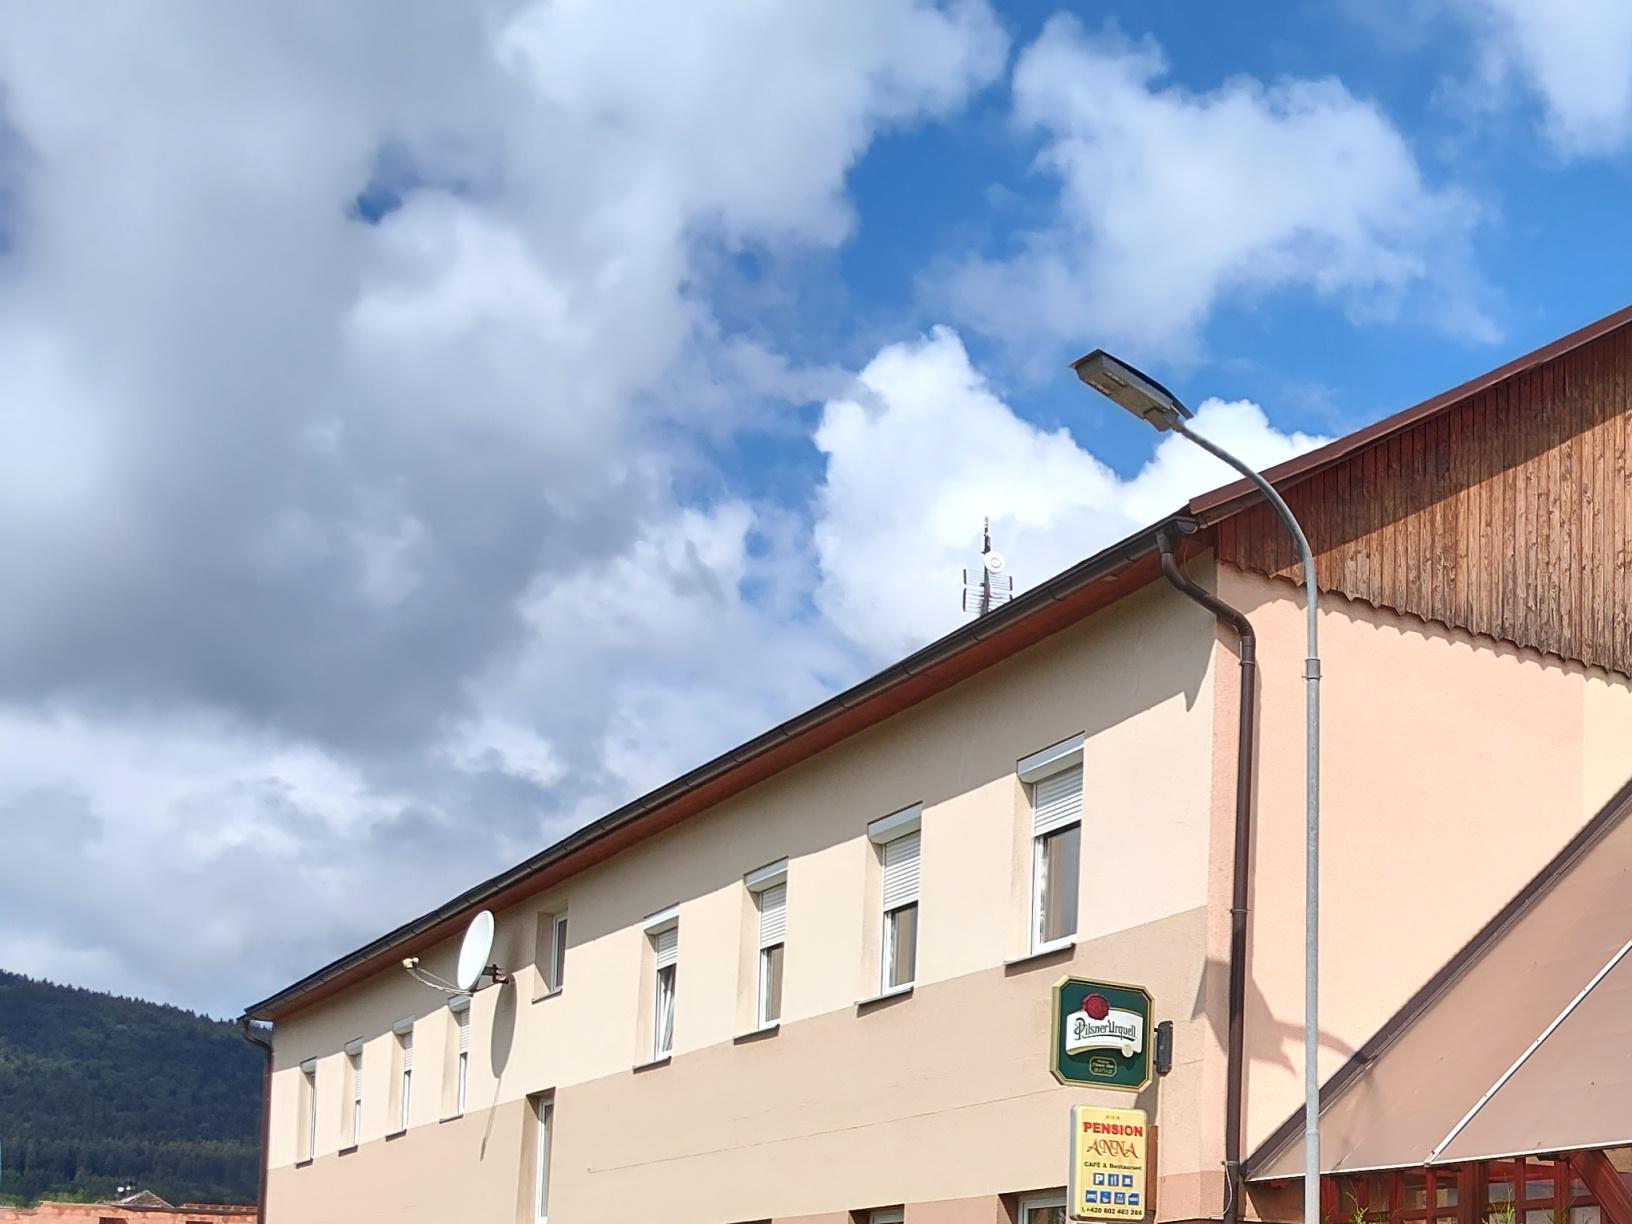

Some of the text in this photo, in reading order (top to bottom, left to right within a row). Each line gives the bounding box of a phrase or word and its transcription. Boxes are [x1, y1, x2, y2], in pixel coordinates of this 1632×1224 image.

[1074, 1017, 1136, 1040] Pilsner Urquell
[1083, 1121, 1143, 1137] PENSION
[1086, 1138, 1140, 1159] ANNA
